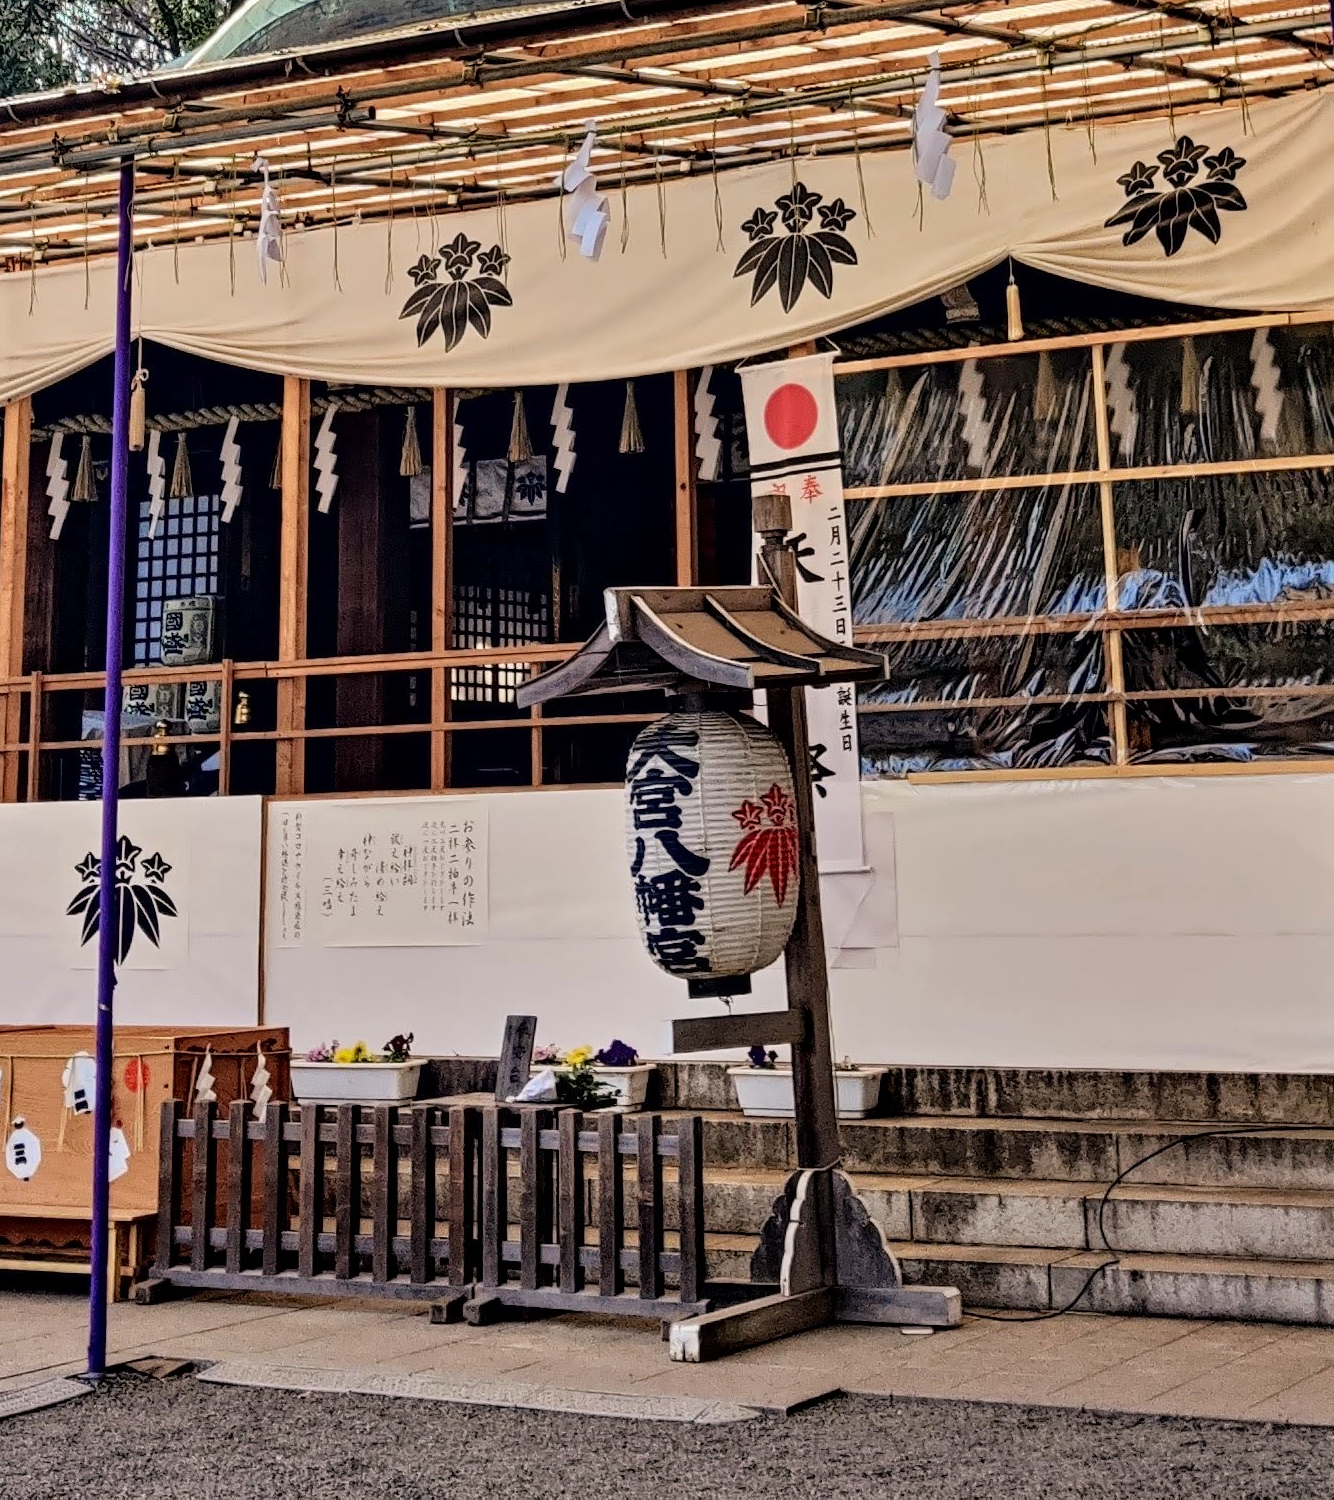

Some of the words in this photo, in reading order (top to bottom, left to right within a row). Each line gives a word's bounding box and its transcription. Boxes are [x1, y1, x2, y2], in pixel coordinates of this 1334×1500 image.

[626, 724, 713, 974] 大宮八幡宮
